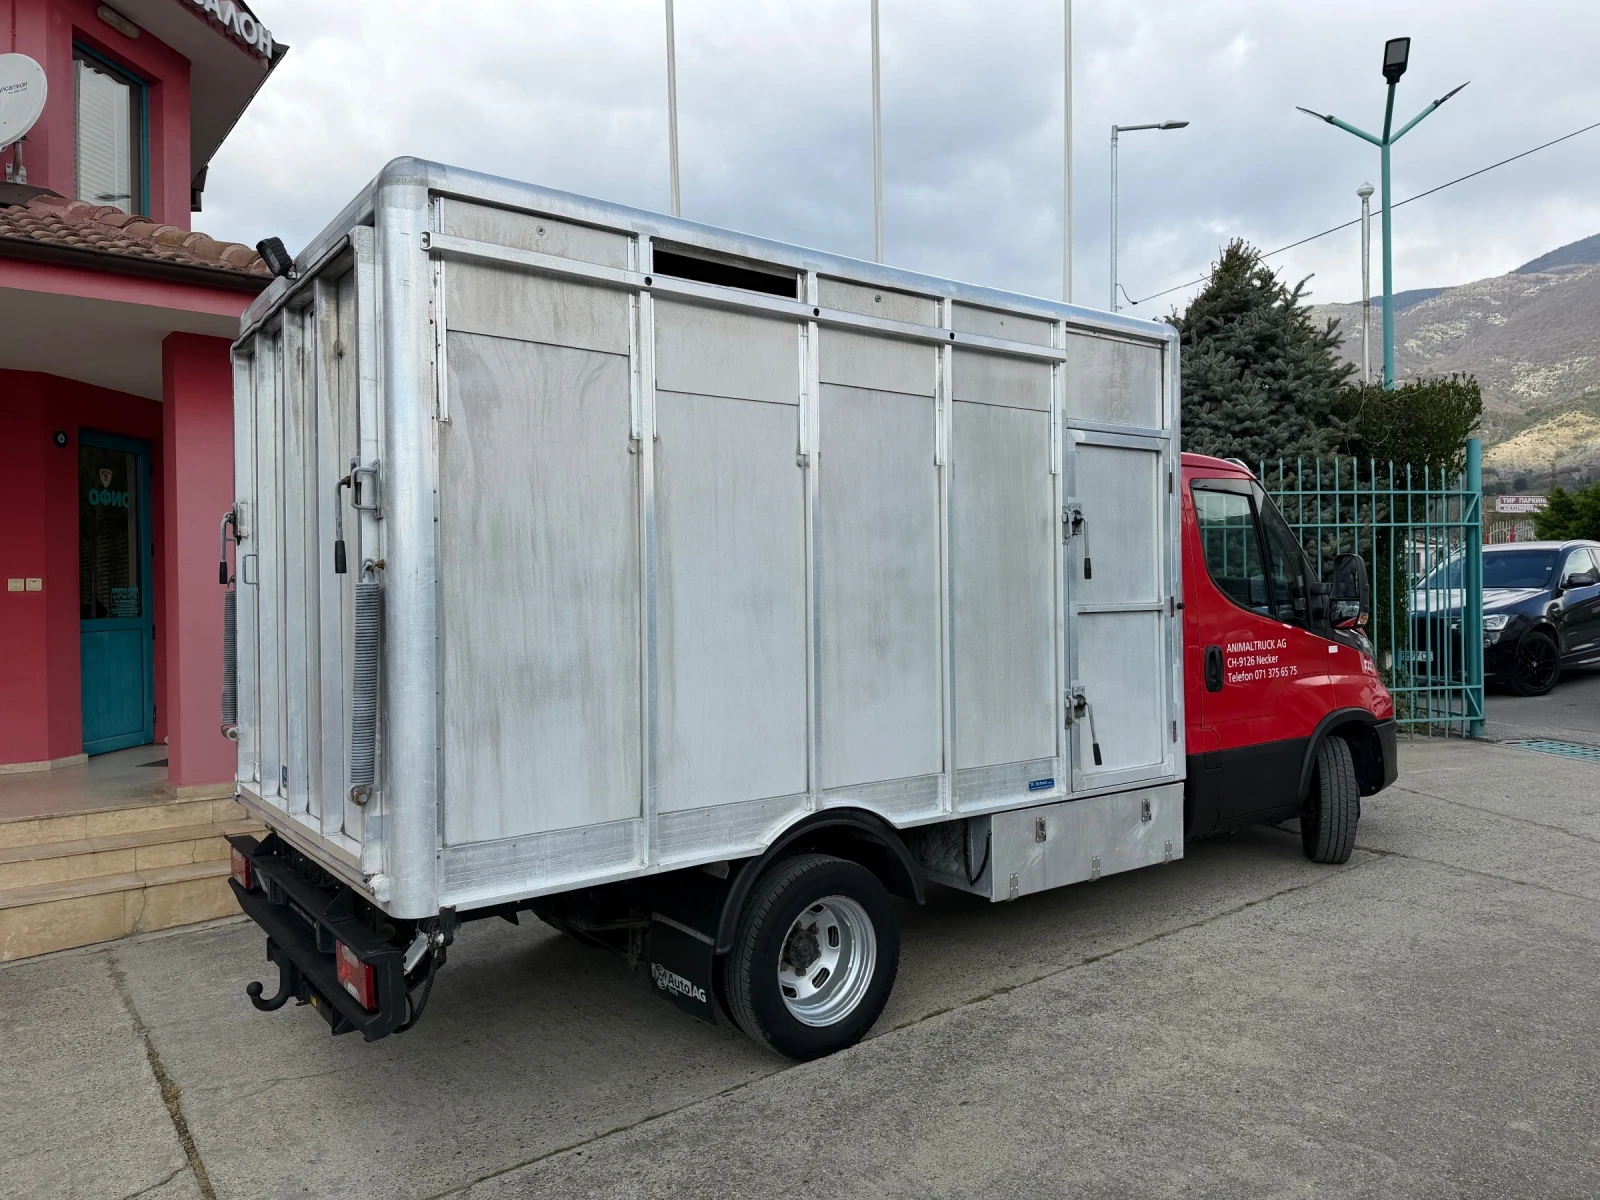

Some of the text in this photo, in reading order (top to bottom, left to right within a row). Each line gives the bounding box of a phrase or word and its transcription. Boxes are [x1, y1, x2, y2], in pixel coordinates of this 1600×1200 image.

[193, 0, 272, 59] АЛОН
[88, 488, 130, 508] ОФИС
[1226, 638, 1287, 653] ANIMALTRUCK AG
[1227, 654, 1279, 668] CH-9126 Necker
[1227, 665, 1298, 683] Telefon 071 375 65 75
